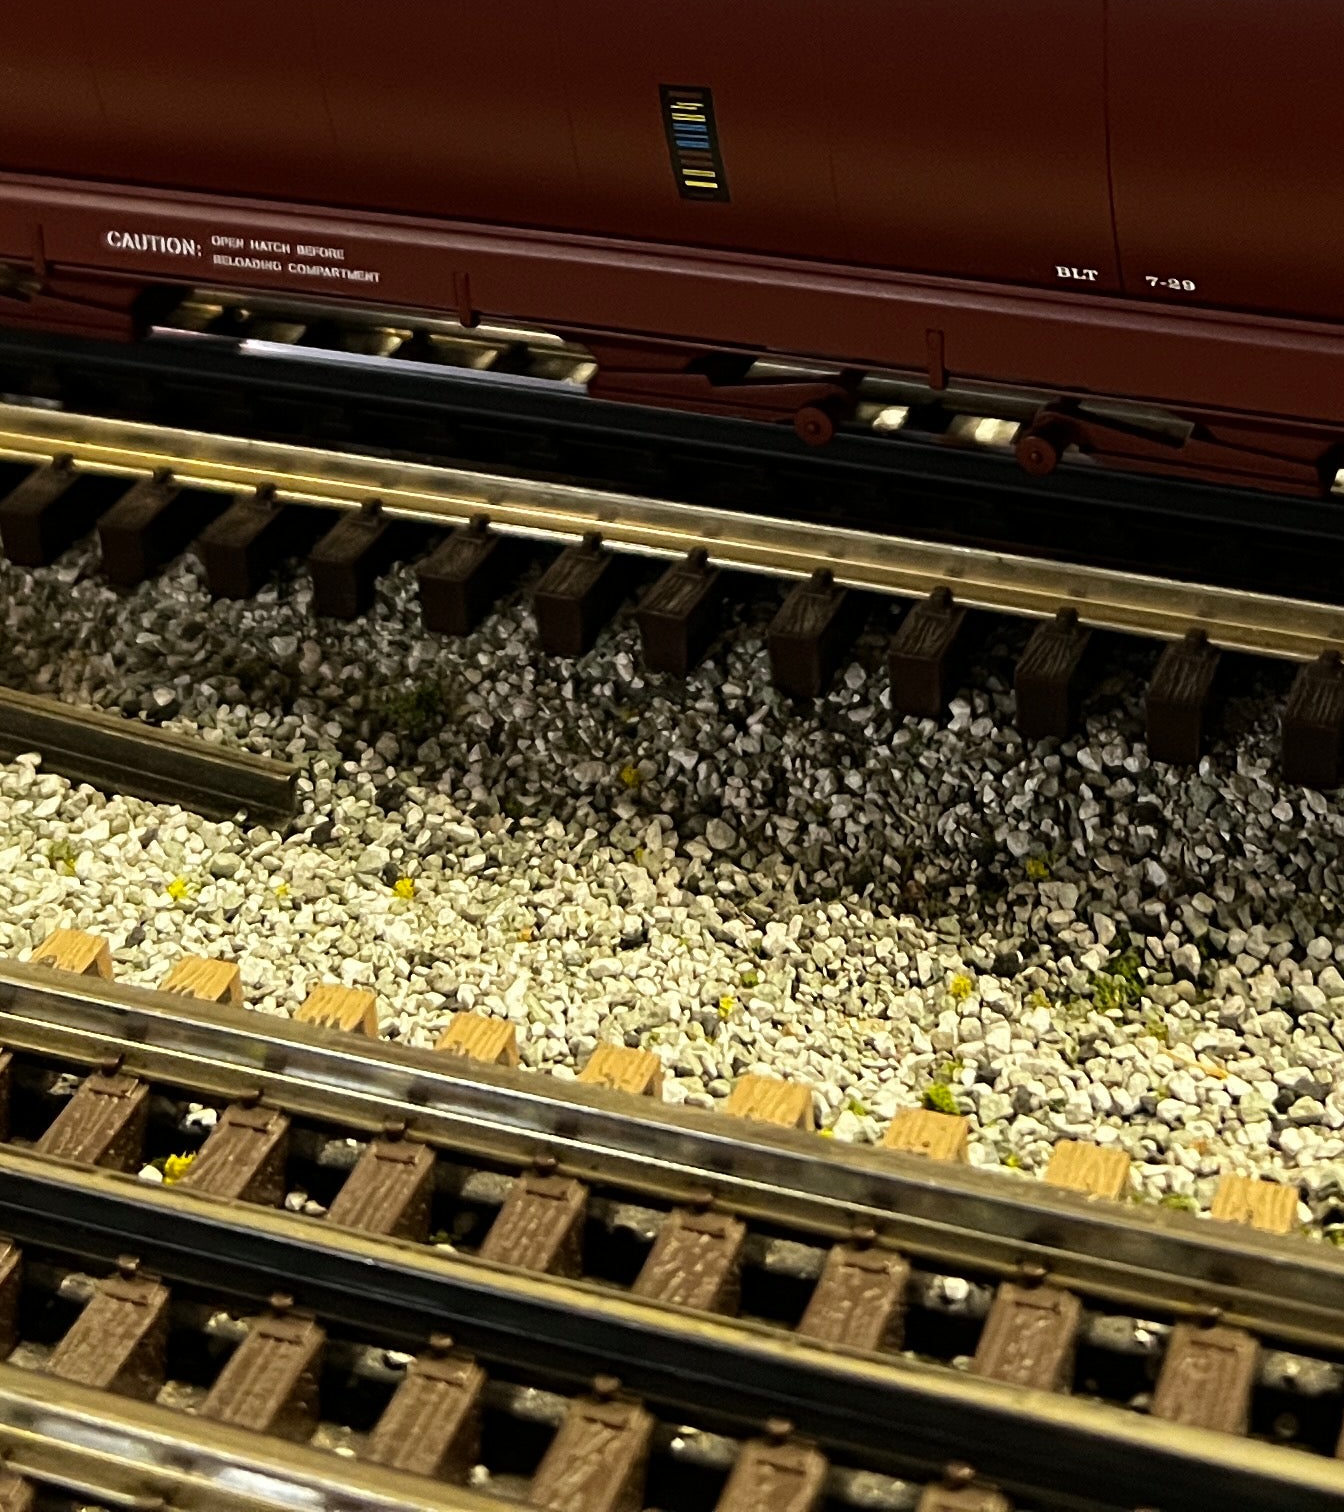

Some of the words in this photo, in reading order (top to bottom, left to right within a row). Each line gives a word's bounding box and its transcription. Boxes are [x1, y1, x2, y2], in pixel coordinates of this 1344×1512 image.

[106, 230, 203, 257] CAUTION:
[211, 235, 245, 249] OPEN
[250, 239, 291, 255] HATCH
[296, 244, 345, 260] BEFORE
[212, 254, 282, 271] RELOADING
[288, 262, 381, 283] COMPARTMENT
[1056, 266, 1098, 281] BLT
